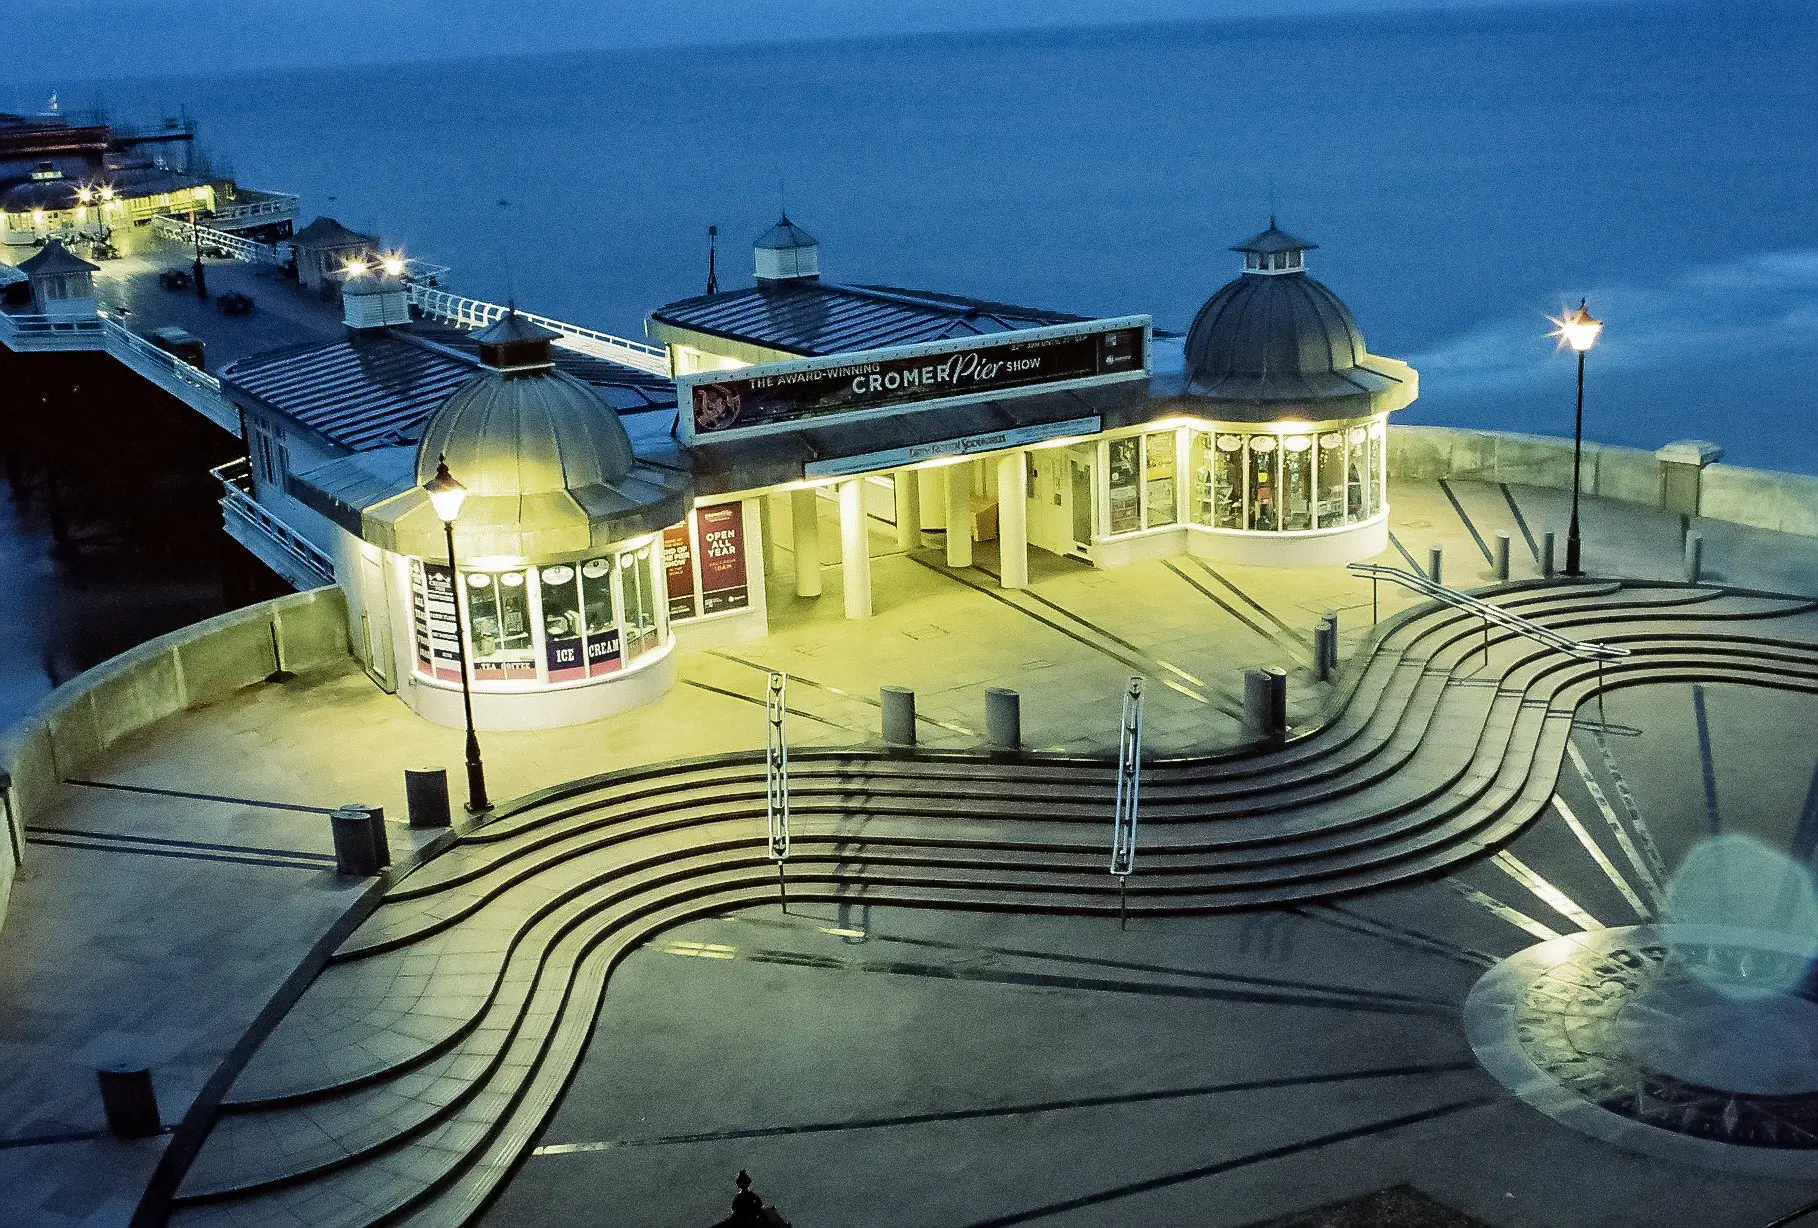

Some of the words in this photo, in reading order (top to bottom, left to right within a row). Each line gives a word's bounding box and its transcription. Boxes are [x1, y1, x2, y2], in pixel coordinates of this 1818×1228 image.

[750, 376, 774, 390] THE
[777, 363, 880, 385] AWARD-WINNING
[852, 363, 950, 394] CROMER
[947, 352, 1004, 384] Pier
[1006, 357, 1041, 372] SHOW
[705, 529, 736, 542] OPEN
[711, 538, 732, 549] ALL
[707, 545, 736, 558] YEAR
[556, 648, 575, 663] ICE
[588, 639, 620, 658] CREAM
